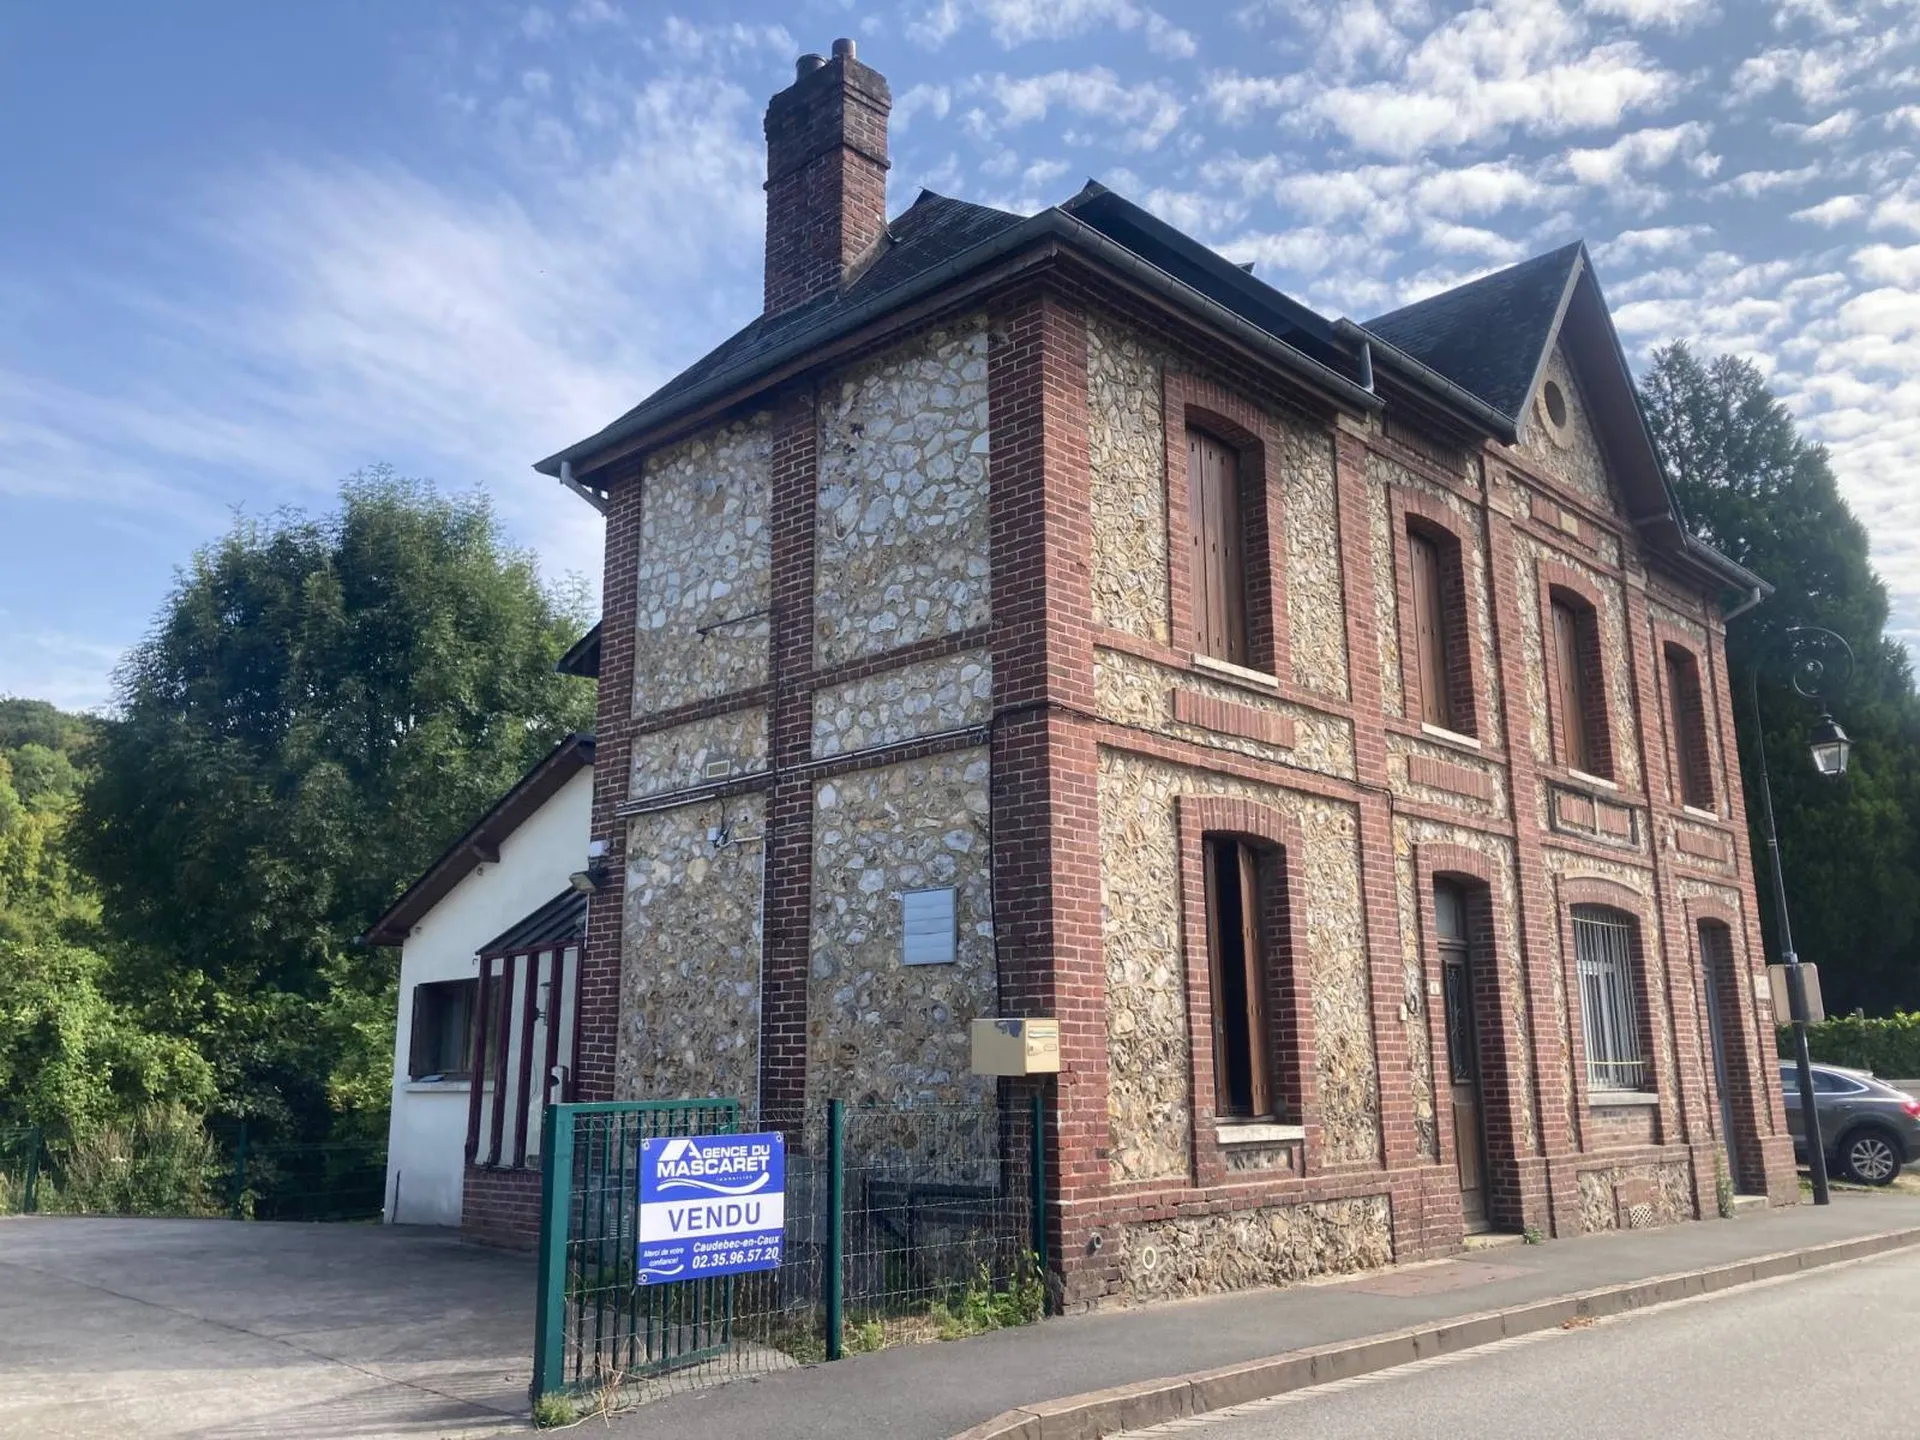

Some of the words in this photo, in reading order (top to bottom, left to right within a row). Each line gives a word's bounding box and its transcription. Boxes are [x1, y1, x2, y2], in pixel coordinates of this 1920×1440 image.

[680, 1140, 748, 1159] AGENCE
[752, 1144, 770, 1156] DU
[657, 1156, 770, 1178] MASCARET
[668, 1201, 761, 1232] VENDU
[693, 1235, 780, 1253] Caudebec-en-Caux
[692, 1246, 779, 1269] 02.35.96.57.20
